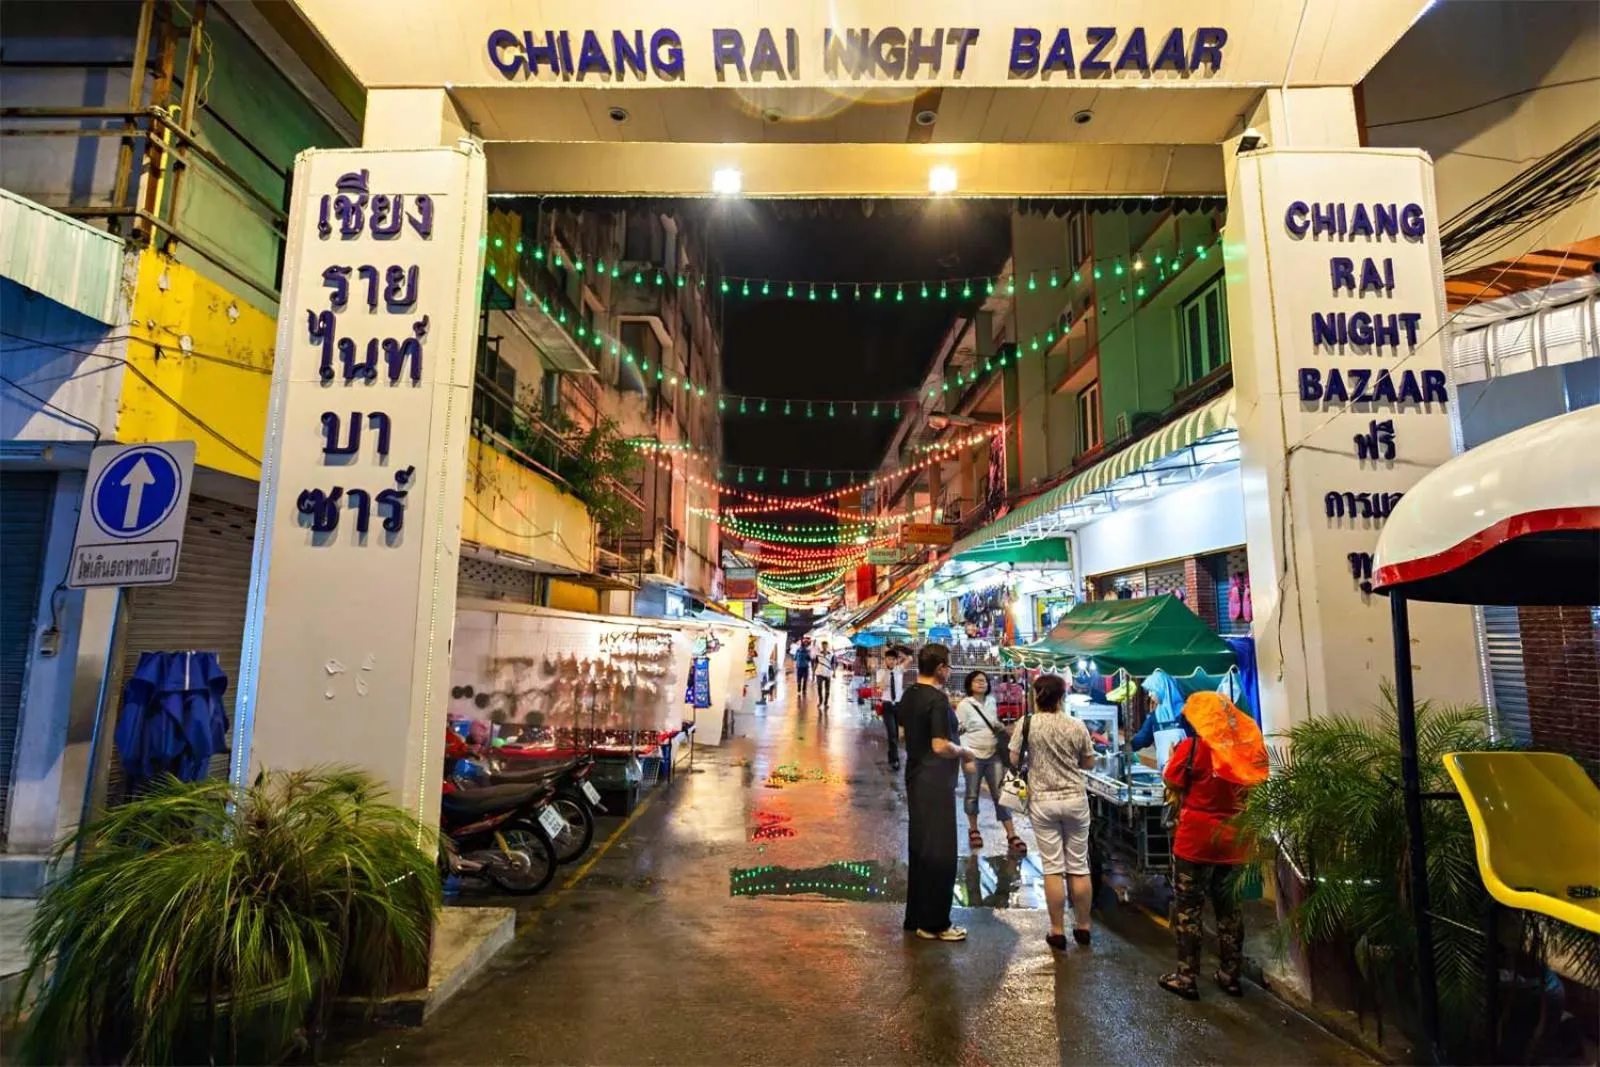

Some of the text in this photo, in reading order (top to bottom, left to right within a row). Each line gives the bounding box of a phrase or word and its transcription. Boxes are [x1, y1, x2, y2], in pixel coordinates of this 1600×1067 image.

[487, 27, 1228, 80] CHIANG RAI NIGHT BAZAAR
[317, 168, 435, 240] เชียง
[1285, 200, 1426, 240] CHIANG
[322, 264, 420, 310] ราย
[1330, 257, 1395, 293] RAI
[306, 308, 431, 383] ไนท์
[1311, 312, 1421, 348] NIGHT
[1298, 367, 1449, 404] BAZAAR
[321, 411, 392, 457] บา
[1353, 419, 1397, 460] ฟรี
[297, 465, 414, 534] ซาร์
